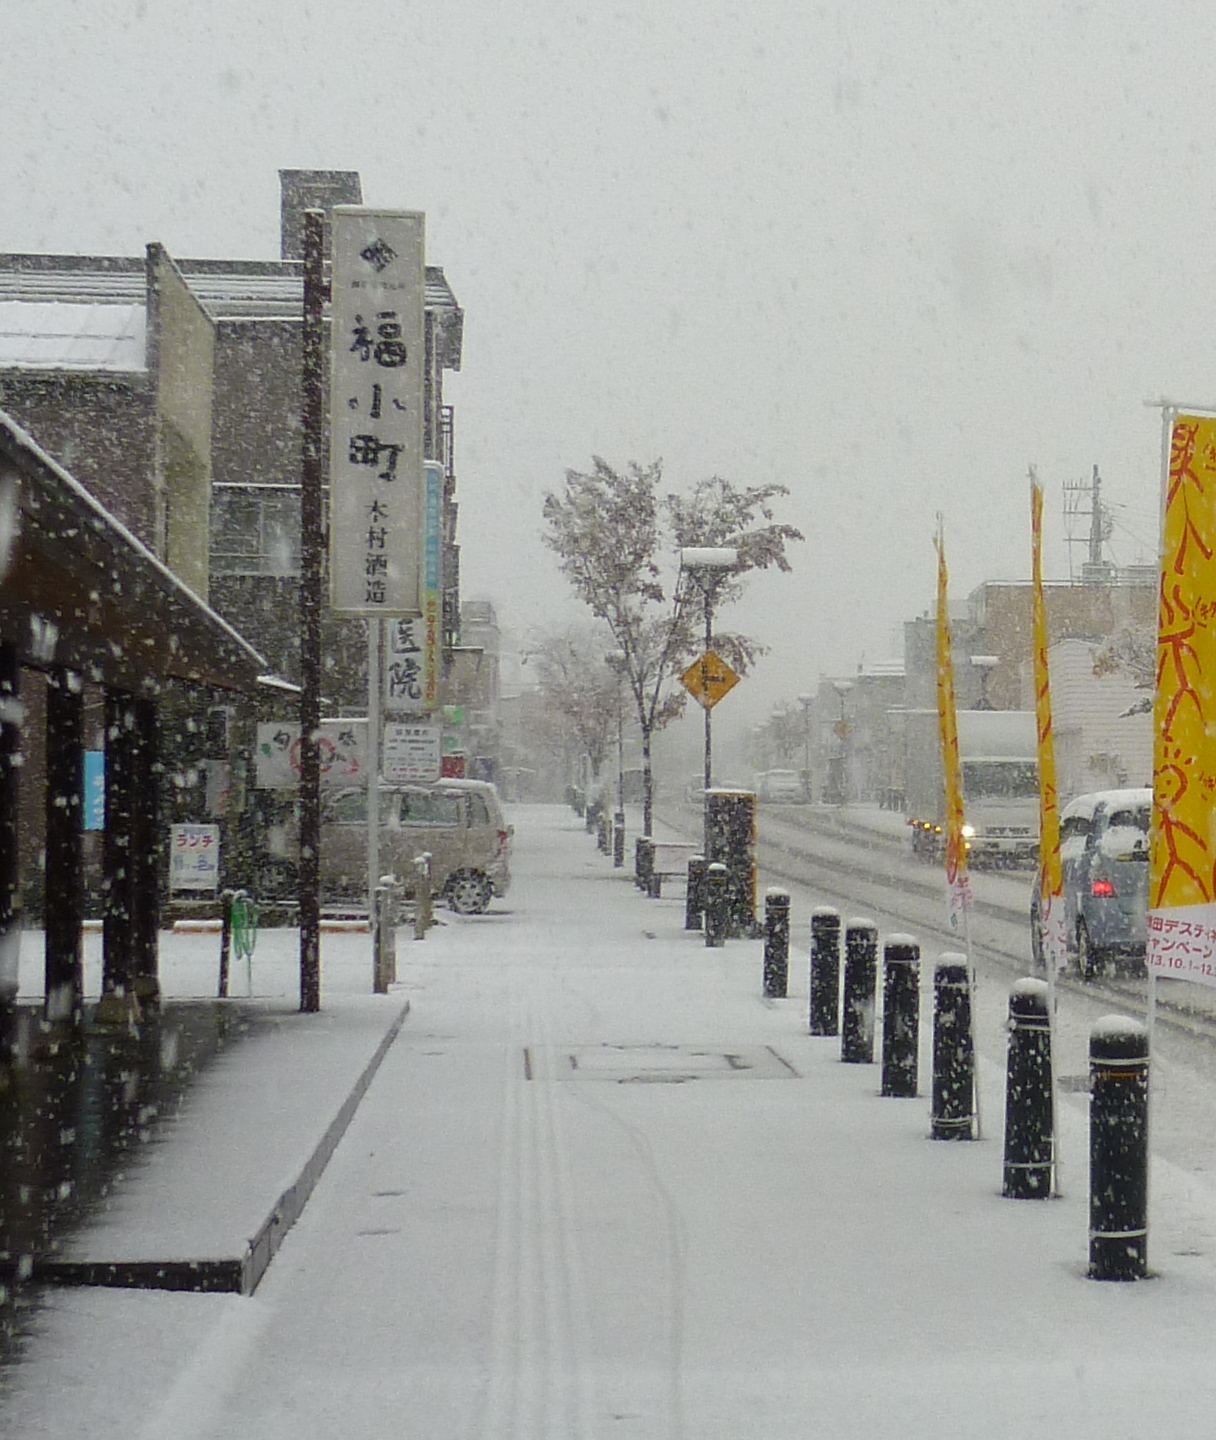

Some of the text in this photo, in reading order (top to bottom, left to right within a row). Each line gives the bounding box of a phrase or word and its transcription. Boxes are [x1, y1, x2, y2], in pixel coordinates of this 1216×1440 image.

[349, 311, 407, 482] 福小町
[365, 499, 389, 605] 木村酒造
[176, 833, 214, 848] ランチ
[1147, 935, 1213, 959] ャンペーン
